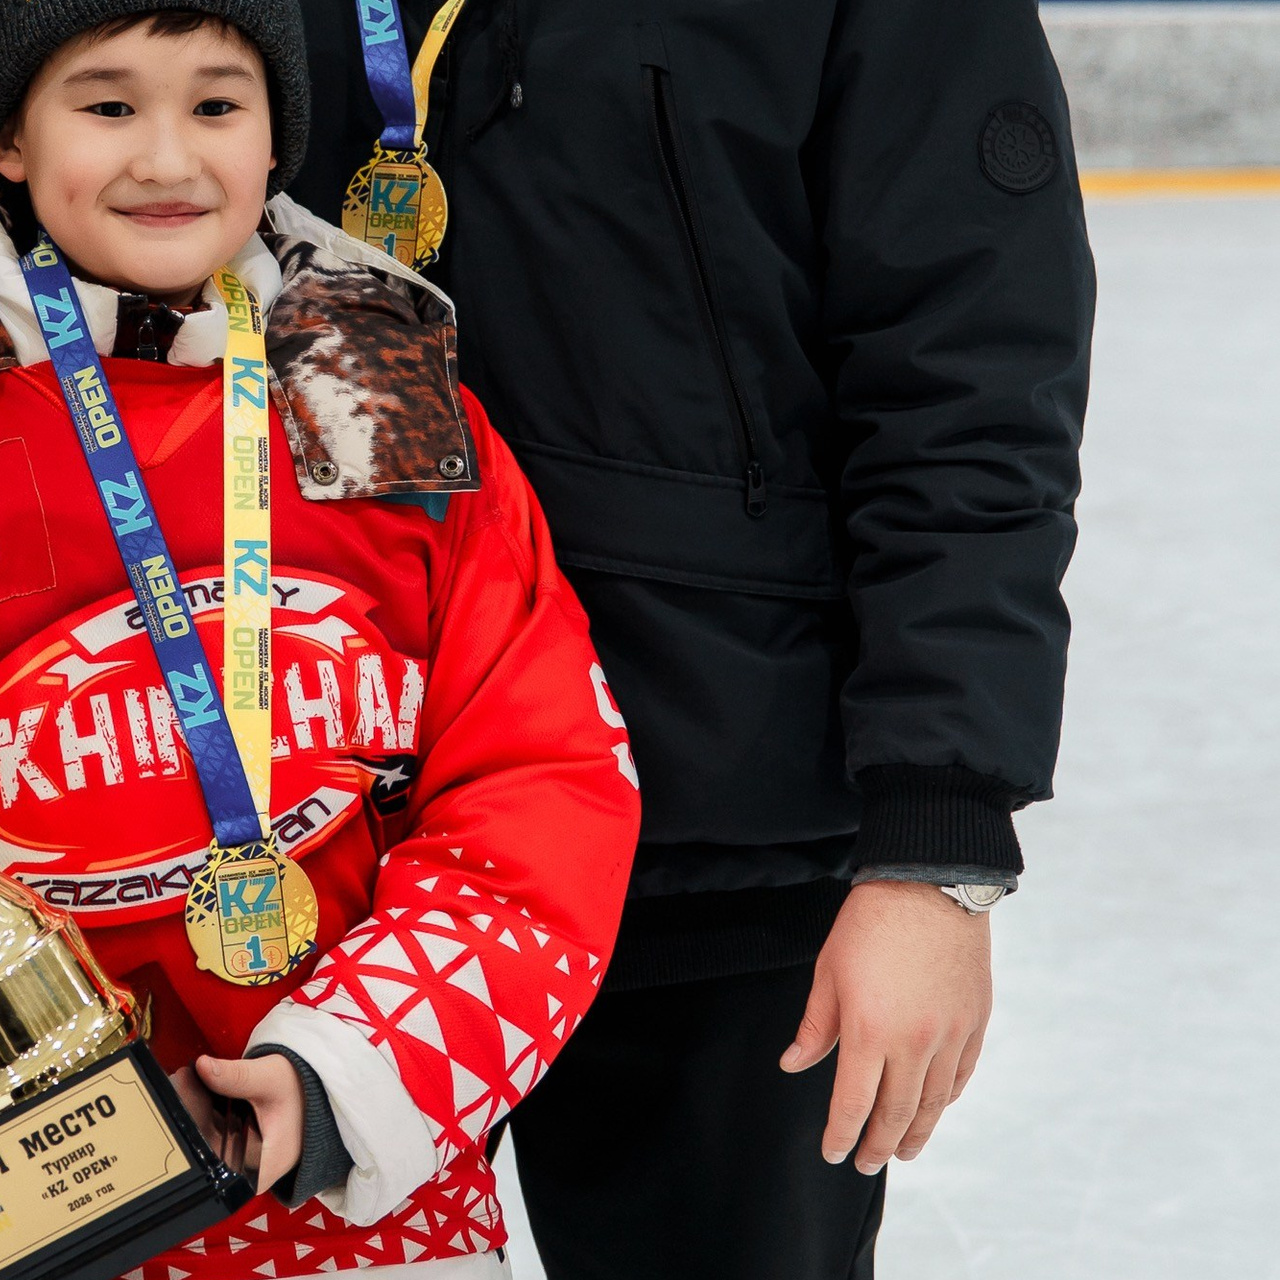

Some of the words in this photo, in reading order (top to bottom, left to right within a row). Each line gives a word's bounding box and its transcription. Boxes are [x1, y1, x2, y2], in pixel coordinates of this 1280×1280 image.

[370, 213, 415, 230] OPEN
[371, 179, 419, 214] KZ
[34, 287, 84, 350] KZ
[222, 273, 250, 333] OPEN
[74, 365, 121, 449] OPEN
[232, 357, 266, 409] KZ
[233, 435, 255, 511] OPEN
[99, 471, 153, 536] KZ
[234, 540, 268, 596] KZ
[141, 554, 190, 639] OPEN
[167, 662, 221, 730] KZ
[233, 627, 255, 710] OPEN
[220, 876, 279, 917] KZ
[224, 912, 281, 934] OPEN
[246, 935, 267, 970] 1
[18, 1094, 117, 1160] место
[41, 1142, 96, 1176] Турнир
[42, 1179, 69, 1200] «KZ
[72, 1155, 118, 1184] OPEN»
[95, 1182, 116, 1198] год
